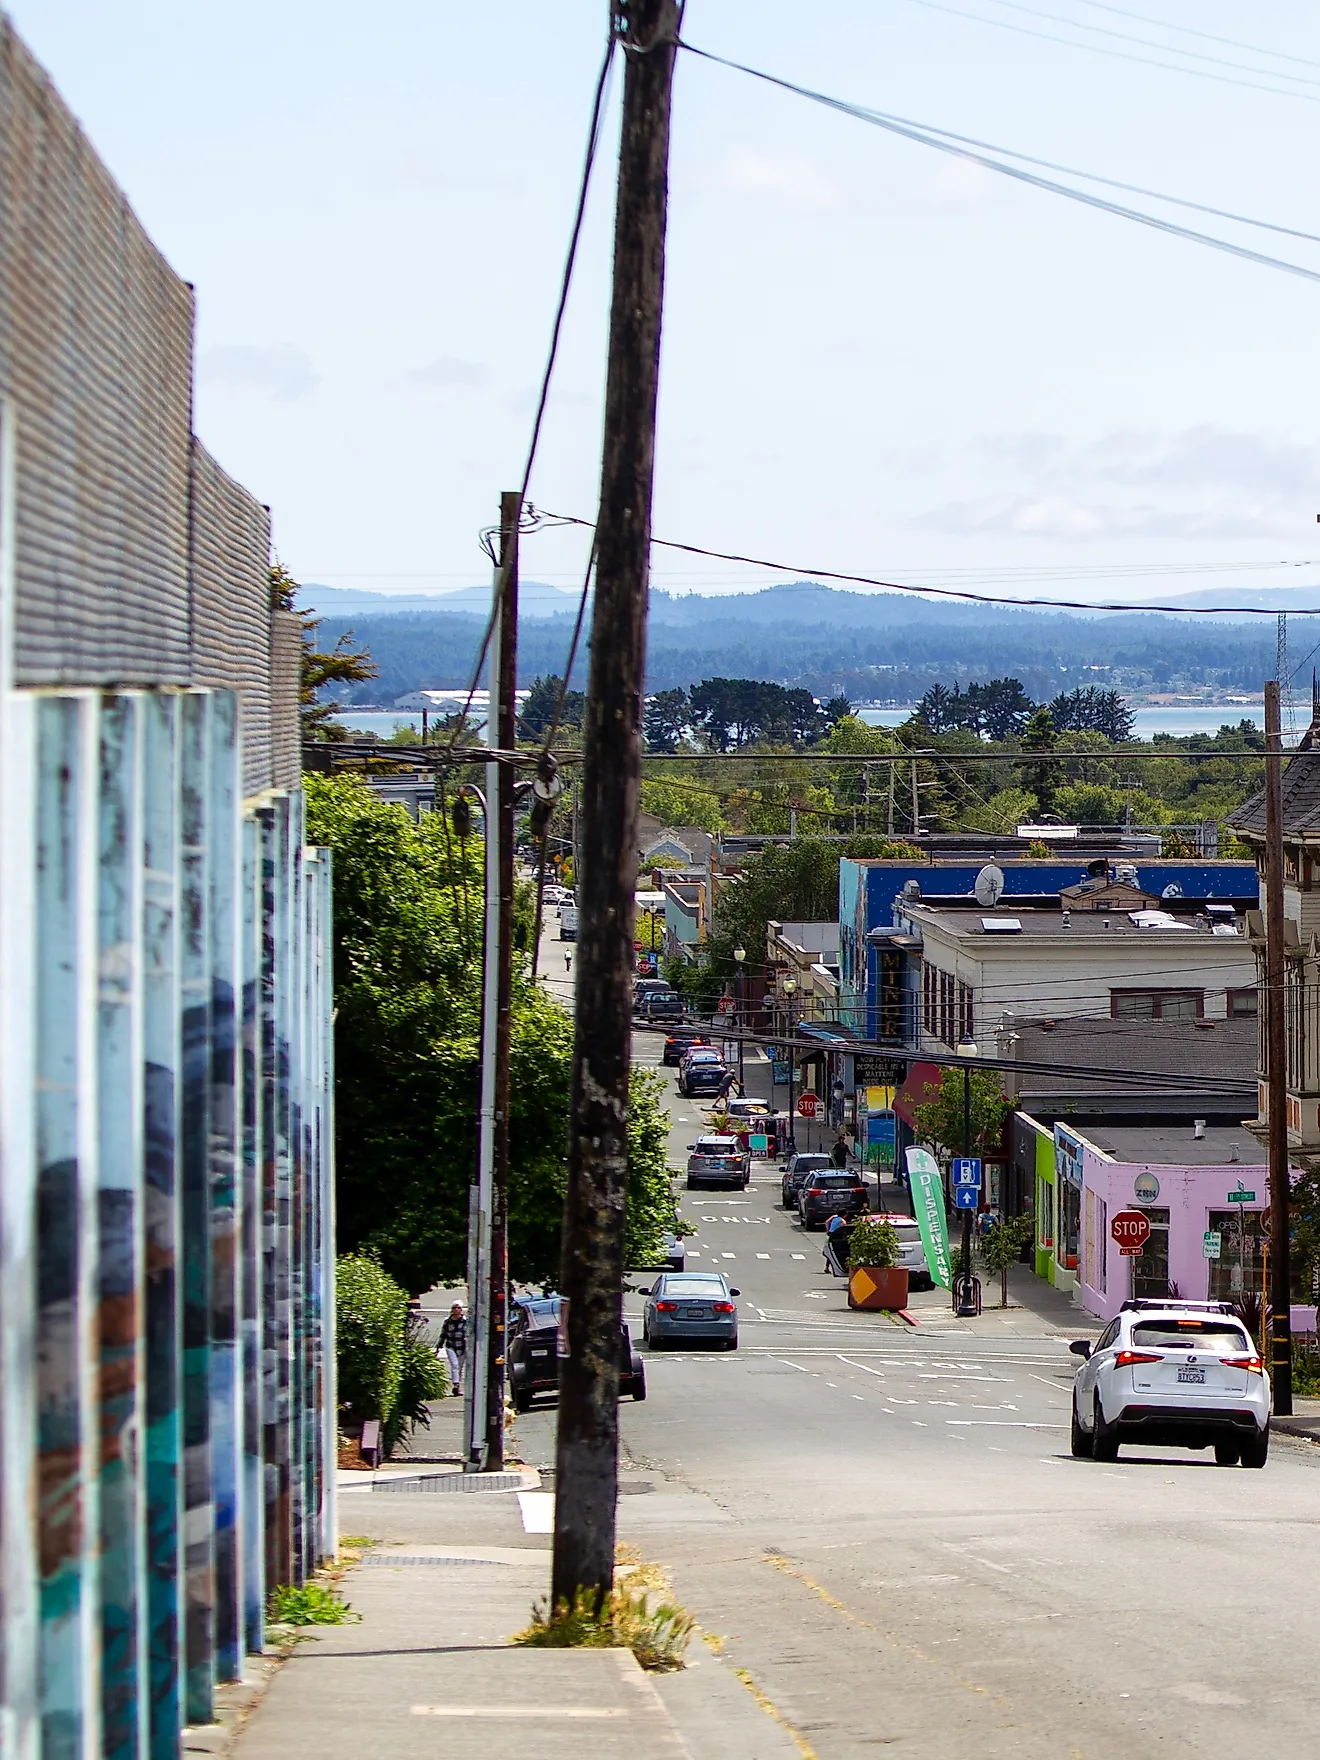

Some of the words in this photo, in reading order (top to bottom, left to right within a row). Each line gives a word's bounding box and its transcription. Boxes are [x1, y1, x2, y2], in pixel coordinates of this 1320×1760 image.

[883, 952, 900, 1035] MINOR
[701, 1215, 771, 1224] ONLY
[919, 1174, 950, 1287] DISPENSARY
[1113, 1221, 1147, 1236] STOP
